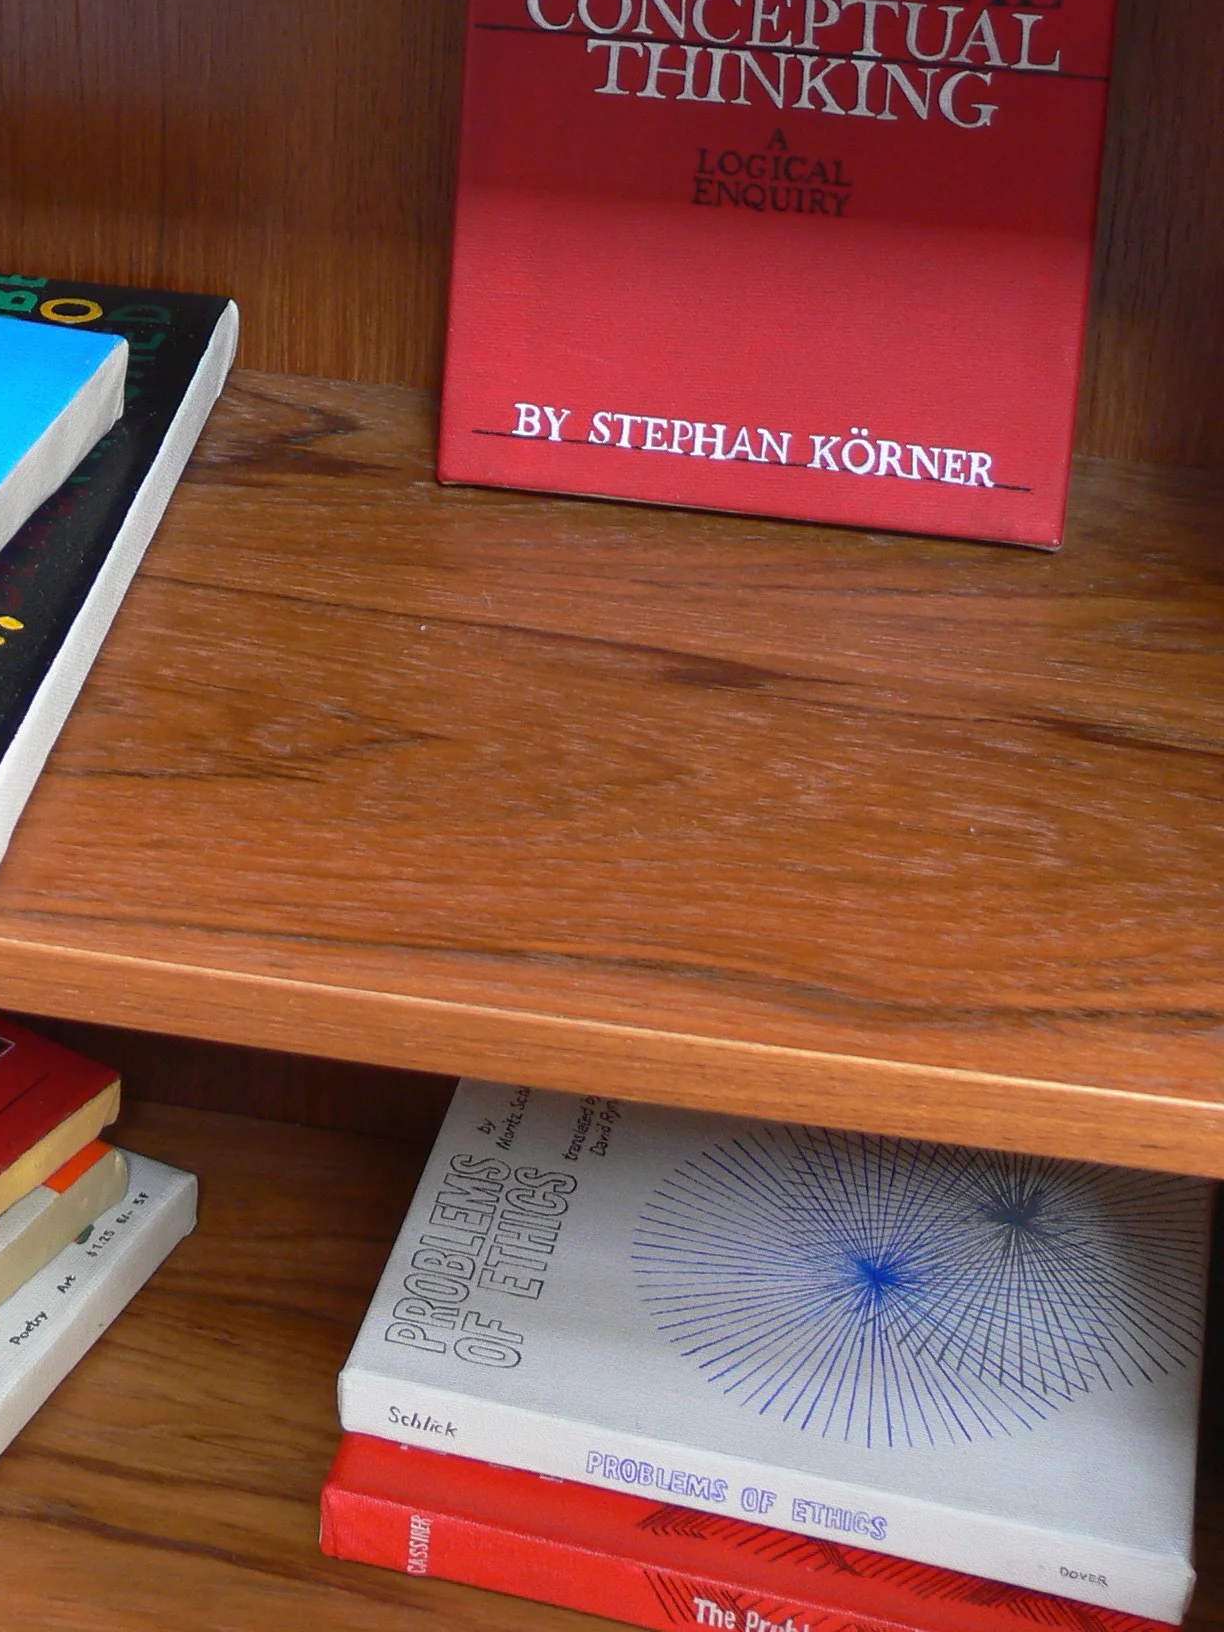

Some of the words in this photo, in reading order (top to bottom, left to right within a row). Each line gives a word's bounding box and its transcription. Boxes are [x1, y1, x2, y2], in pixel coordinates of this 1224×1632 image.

[587, 38, 999, 129] THINKING
[765, 126, 790, 151] A
[697, 148, 854, 187] LOGICAL
[692, 177, 852, 218] ENQUIRY
[512, 402, 572, 442] BY
[588, 411, 790, 465] STEPHAN
[807, 427, 995, 488] KÖRNER
[476, 1118, 497, 1135] by
[495, 1111, 523, 1151] Moritz
[589, 1123, 611, 1157] David
[384, 1153, 512, 1354] PROBLEMS
[477, 1167, 578, 1301] ETHICS
[8, 1310, 49, 1346] Poetry
[56, 1273, 76, 1294] Art
[453, 1311, 524, 1369] OF
[387, 1404, 458, 1439] Schlick
[585, 1450, 729, 1503] PROBLEMS
[740, 1485, 777, 1514] OF
[791, 1496, 888, 1541] ETHICS
[406, 1514, 432, 1576] CASSIRER
[1059, 1566, 1108, 1587] DOVER
[692, 1595, 736, 1630] The
